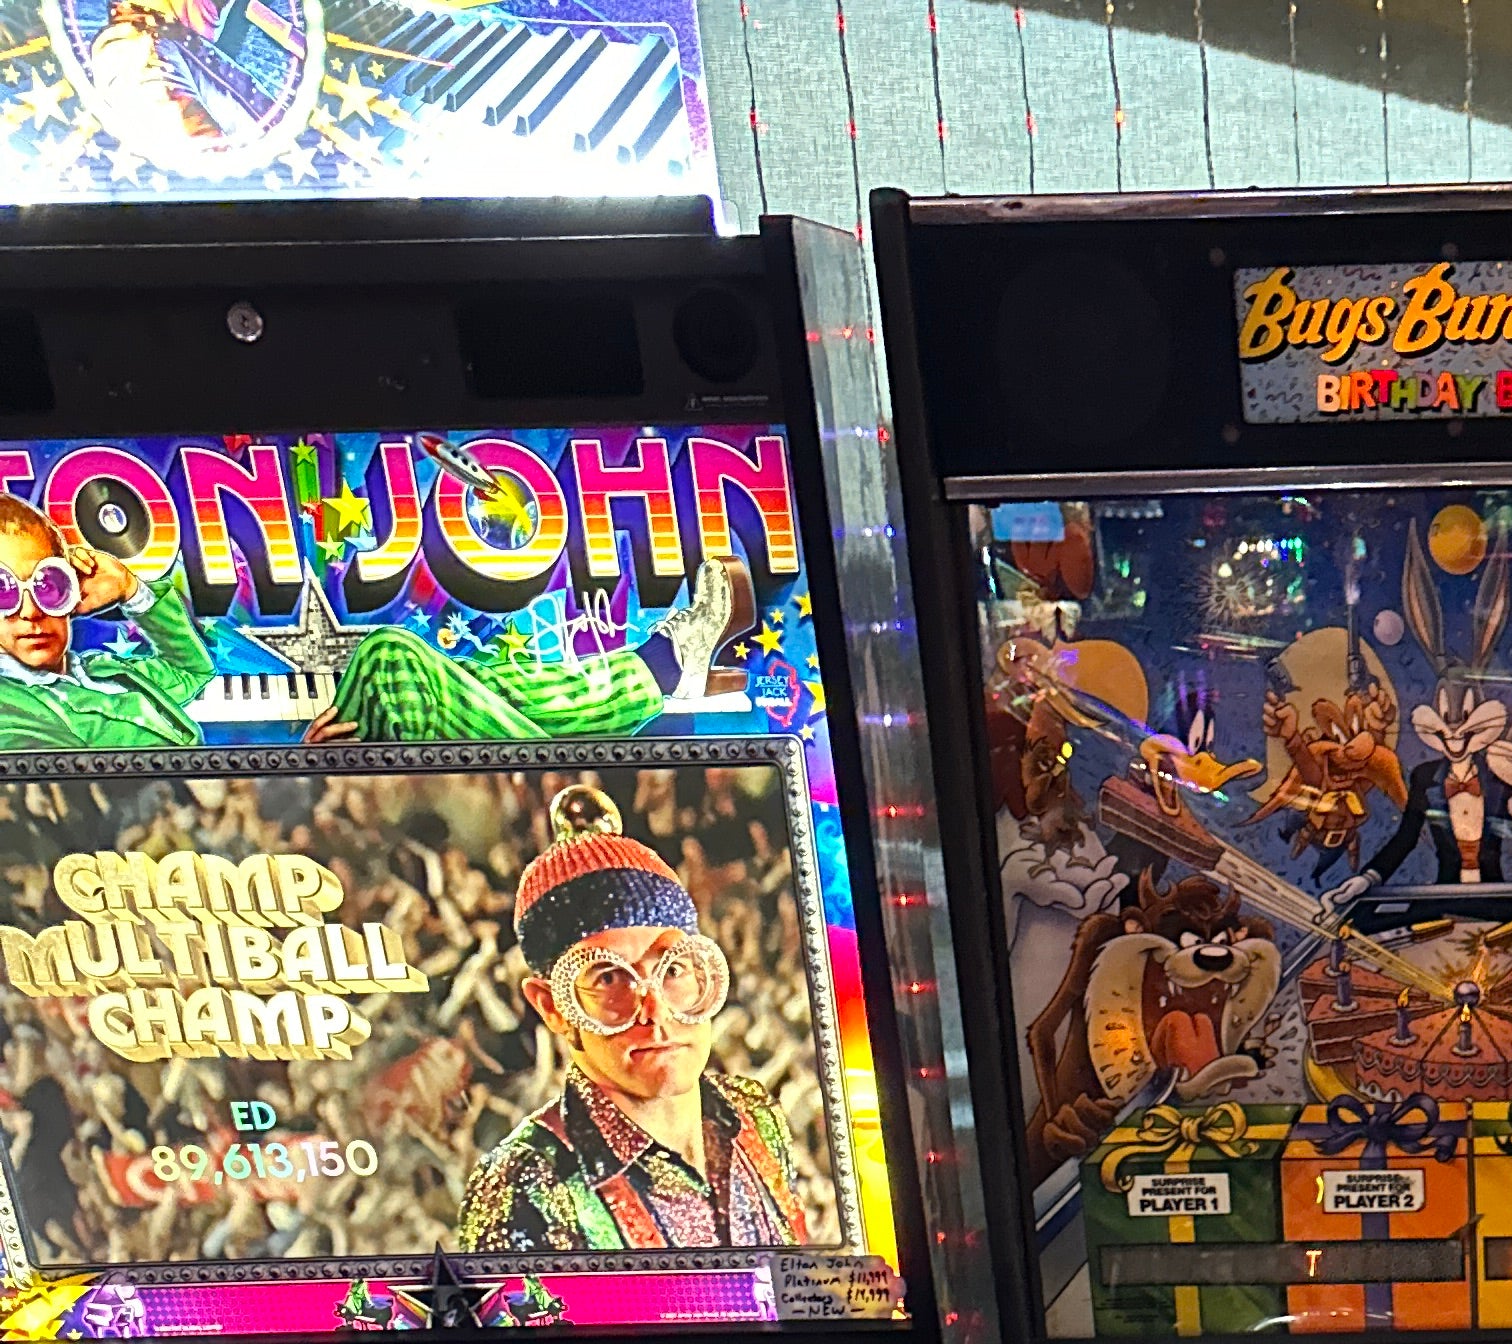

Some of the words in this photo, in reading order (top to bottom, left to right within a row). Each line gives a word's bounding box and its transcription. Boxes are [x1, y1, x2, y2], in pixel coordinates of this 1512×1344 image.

[1238, 266, 1396, 362] Bugs
[1316, 368, 1486, 414] BIRTHDAY
[0, 445, 302, 584] ON
[356, 435, 799, 583] JOHN
[761, 687, 787, 698] JACK
[53, 850, 344, 927] CHAMP
[0, 919, 430, 994] MULTIBALL
[87, 986, 372, 1062] CHAMP
[230, 1101, 277, 1132] ED
[151, 1139, 378, 1186] 89,613,150
[1141, 1187, 1192, 1197] PRESENT
[1194, 1186, 1217, 1196] FOR
[1151, 1177, 1206, 1188] SURPRISE
[1336, 1183, 1387, 1194] PRESENT
[1389, 1182, 1411, 1193] FOR
[1345, 1173, 1400, 1184] SURPRISE
[1139, 1198, 1208, 1213] PLAYER
[1210, 1197, 1219, 1211] 1
[1333, 1195, 1402, 1209] PLAYER
[1403, 1194, 1415, 1208] 2
[781, 1258, 818, 1272] Elton
[826, 1258, 863, 1268] John
[1306, 1249, 1323, 1277] T
